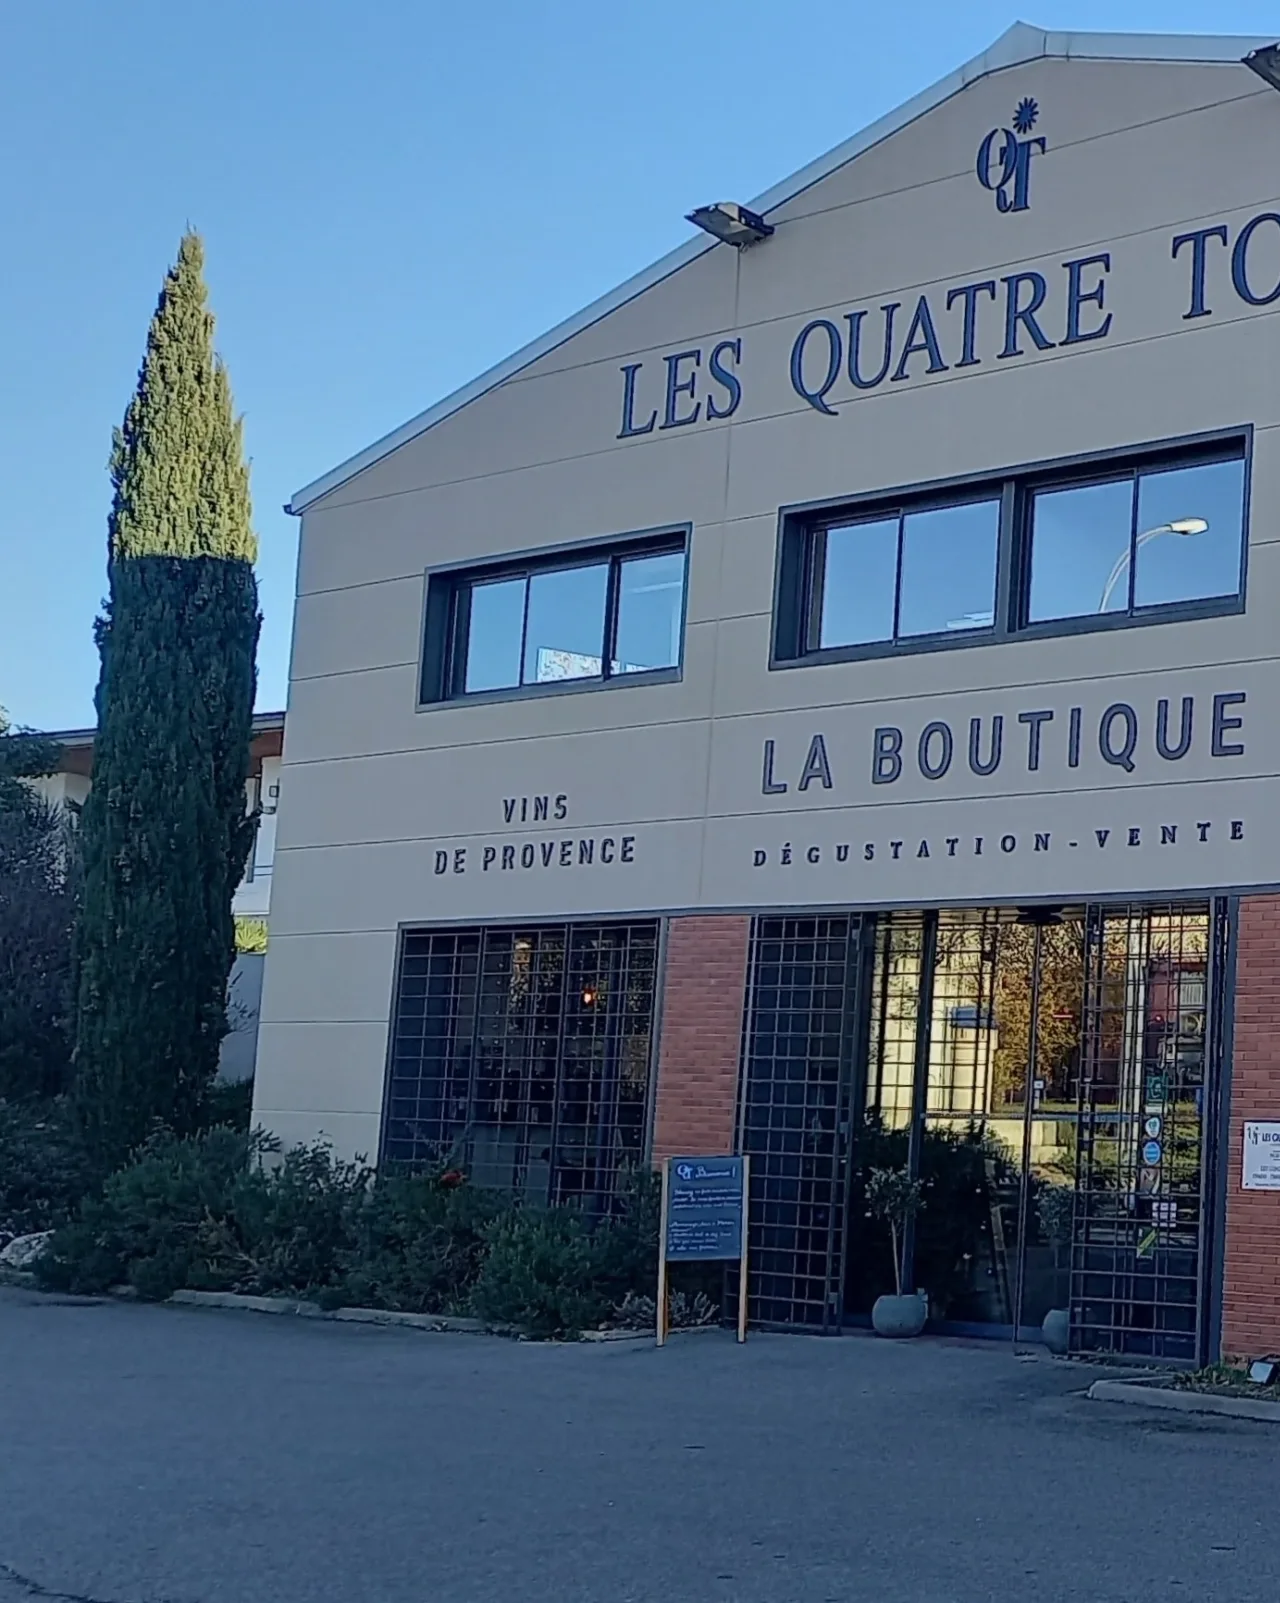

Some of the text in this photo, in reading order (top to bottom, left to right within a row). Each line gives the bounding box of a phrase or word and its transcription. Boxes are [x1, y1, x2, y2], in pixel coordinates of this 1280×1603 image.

[616, 337, 742, 439] LES
[789, 254, 1113, 416] QUATRE
[761, 692, 1247, 795] LA BOUTIQUE
[502, 794, 568, 824] VINS
[434, 836, 636, 875] DE PROVENCE
[1262, 1133, 1271, 1142] LES
